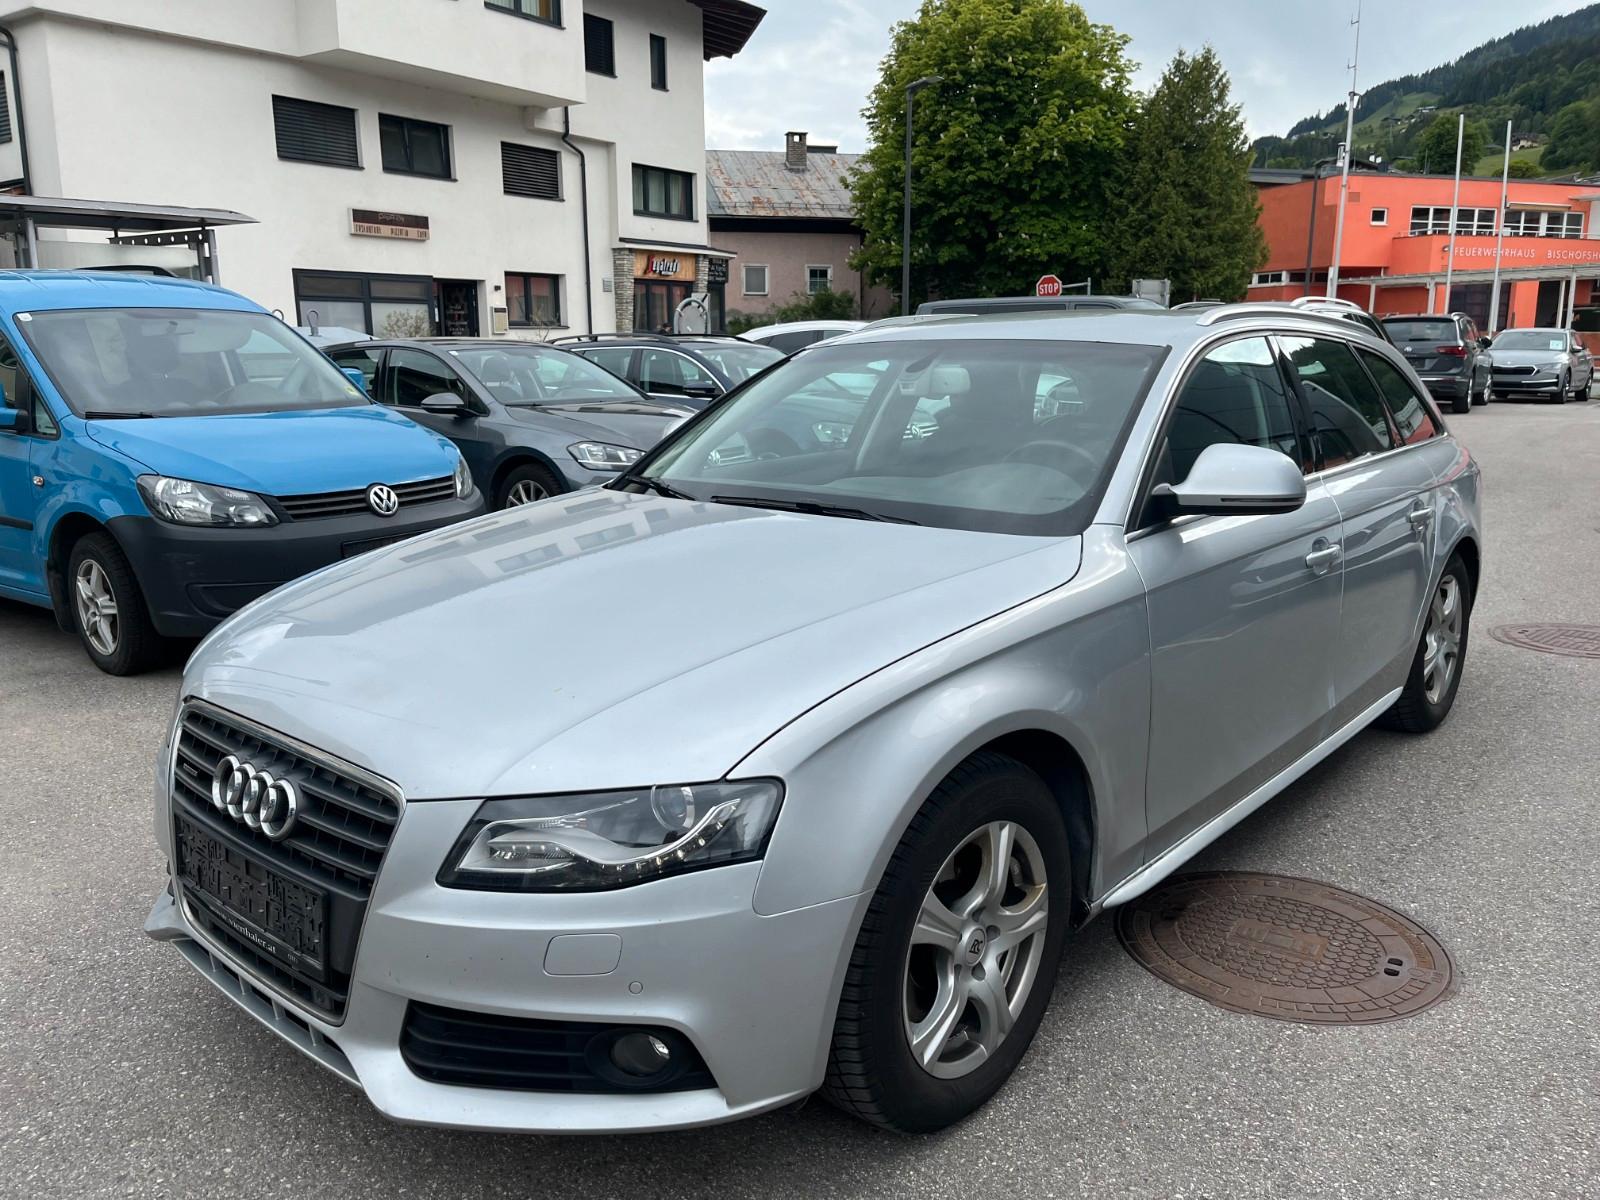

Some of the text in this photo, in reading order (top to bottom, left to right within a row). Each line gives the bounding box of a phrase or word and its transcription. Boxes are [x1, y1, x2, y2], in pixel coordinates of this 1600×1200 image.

[1454, 247, 1600, 260] FEUERWEHRHAUS BISCHOFSH
[1039, 282, 1059, 295] STOP
